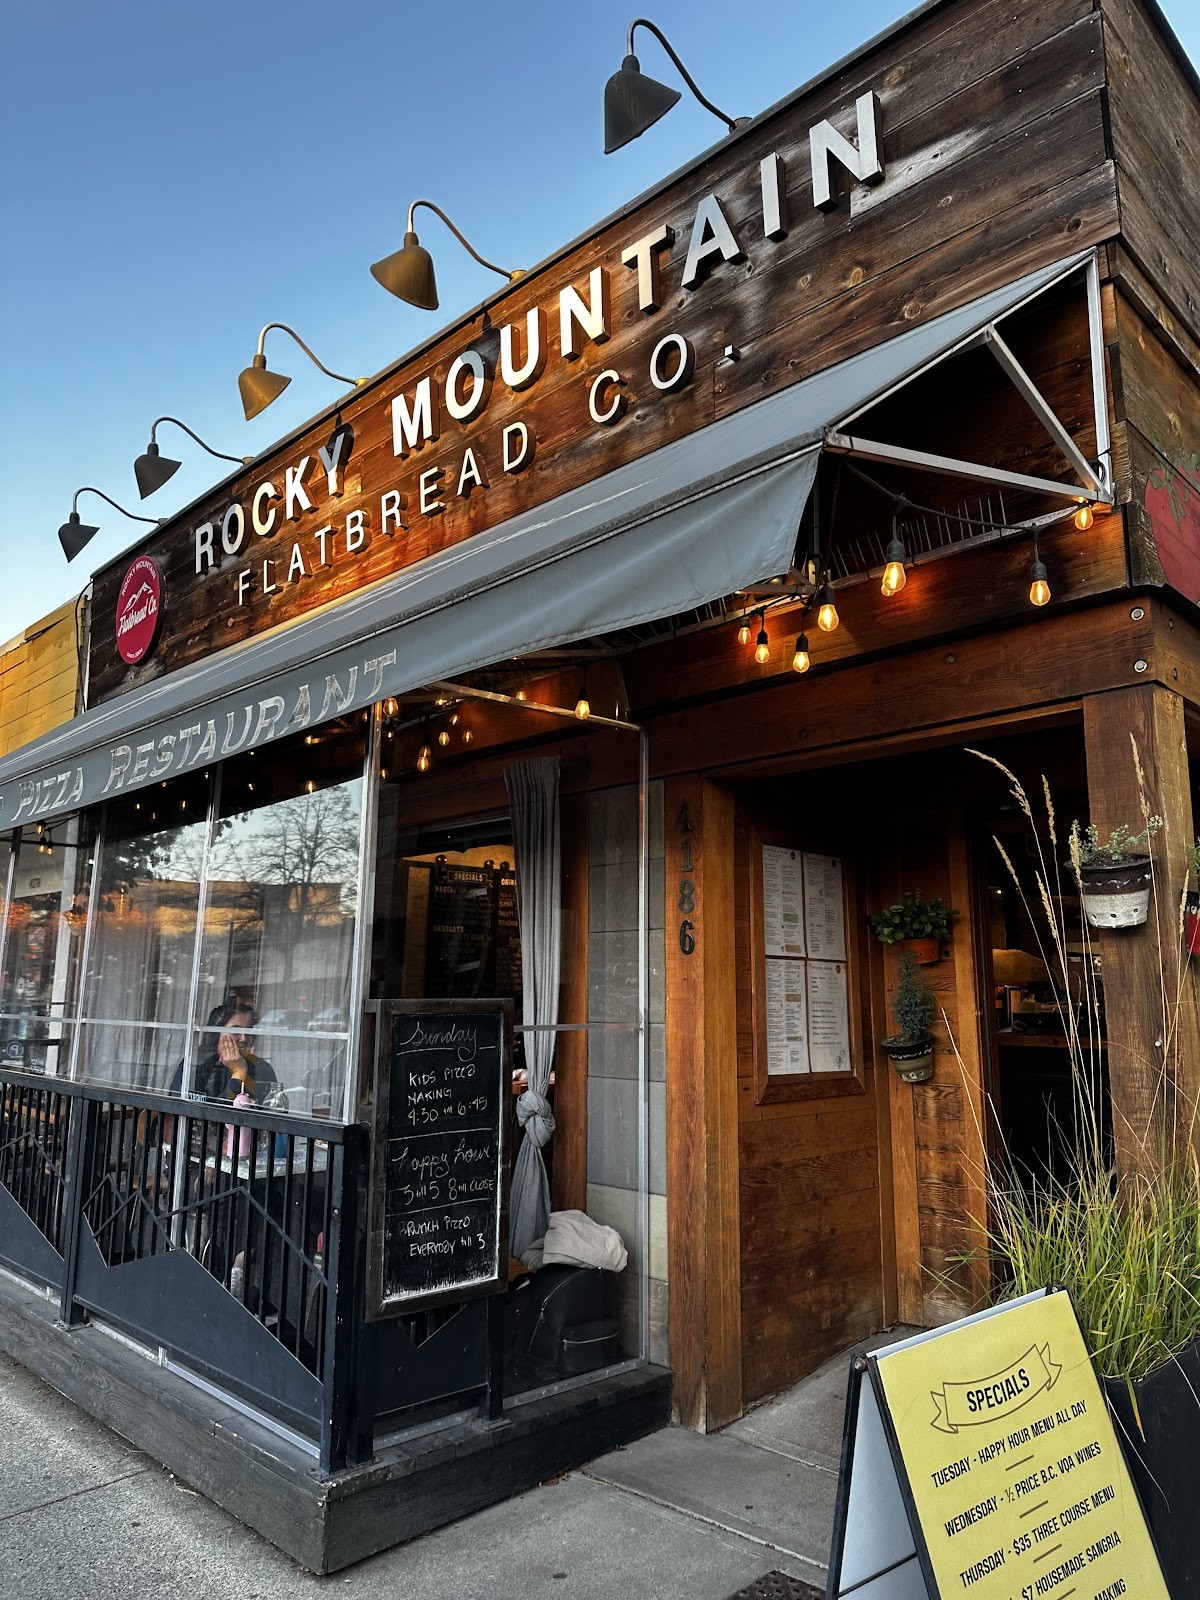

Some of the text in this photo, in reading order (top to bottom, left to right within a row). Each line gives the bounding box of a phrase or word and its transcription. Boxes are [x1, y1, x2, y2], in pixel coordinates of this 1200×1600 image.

[195, 90, 885, 574] ROCKY MOUNTAIN
[238, 333, 740, 606] FLATBREAD CO.
[121, 560, 157, 596] ROCKY MOUNTAIN
[117, 598, 148, 638] Flatbread
[11, 649, 397, 821] PIZZA RESTAURANT
[453, 872, 483, 882] SPECIALS
[501, 878, 517, 886] DRIN
[400, 1021, 477, 1062] Sunday
[407, 1087, 452, 1106] MAKING
[409, 1071, 436, 1087] KIDS
[407, 1107, 439, 1126] 4:30
[457, 1096, 488, 1116] 6:45
[429, 1181, 440, 1200] 5
[448, 1177, 458, 1200] 8
[476, 1233, 486, 1250] 3
[967, 1368, 1030, 1412] SPECIALS
[931, 1456, 971, 1488] TUESDAY
[978, 1438, 1007, 1465] HAPPY
[1007, 1430, 1031, 1449] HOUR
[1031, 1417, 1055, 1438] MENU
[1055, 1408, 1072, 1425] ALL
[1071, 1399, 1088, 1418] DAY
[944, 1495, 998, 1537] WEDNESDAY
[1015, 1473, 1041, 1498] PRICE
[1040, 1465, 1058, 1485] B.C.
[1056, 1455, 1076, 1474] VQA
[1074, 1441, 1102, 1465] WINES
[959, 1548, 1006, 1588] THURSDAY
[1013, 1533, 1032, 1556] $35
[1031, 1516, 1060, 1544] THREE
[1059, 1498, 1092, 1527] COURSE
[1090, 1484, 1115, 1509] MENU
[1035, 1552, 1087, 1596] HOUSEMADE
[1086, 1530, 1122, 1563] SANGRIA
